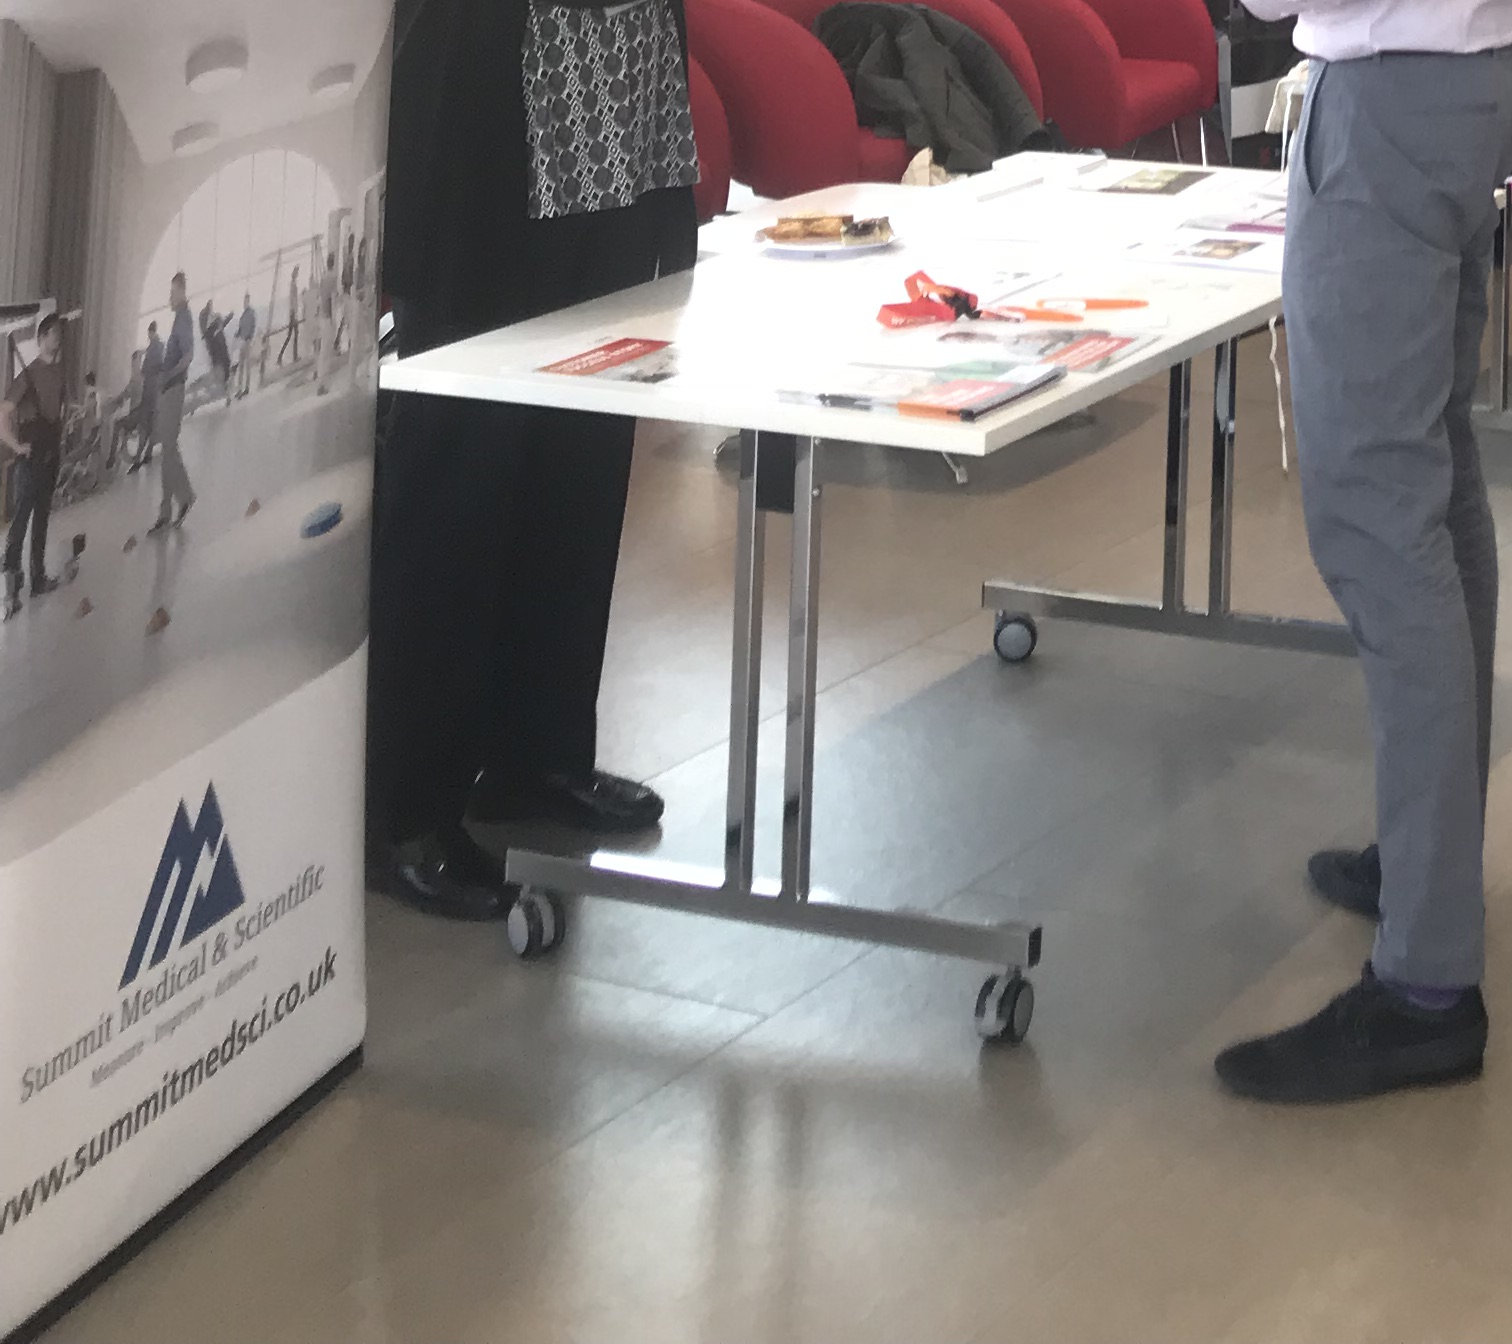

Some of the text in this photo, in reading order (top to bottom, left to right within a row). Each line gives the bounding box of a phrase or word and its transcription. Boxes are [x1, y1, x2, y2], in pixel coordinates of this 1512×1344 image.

[19, 862, 326, 1105] Summit Medical & Scientific
